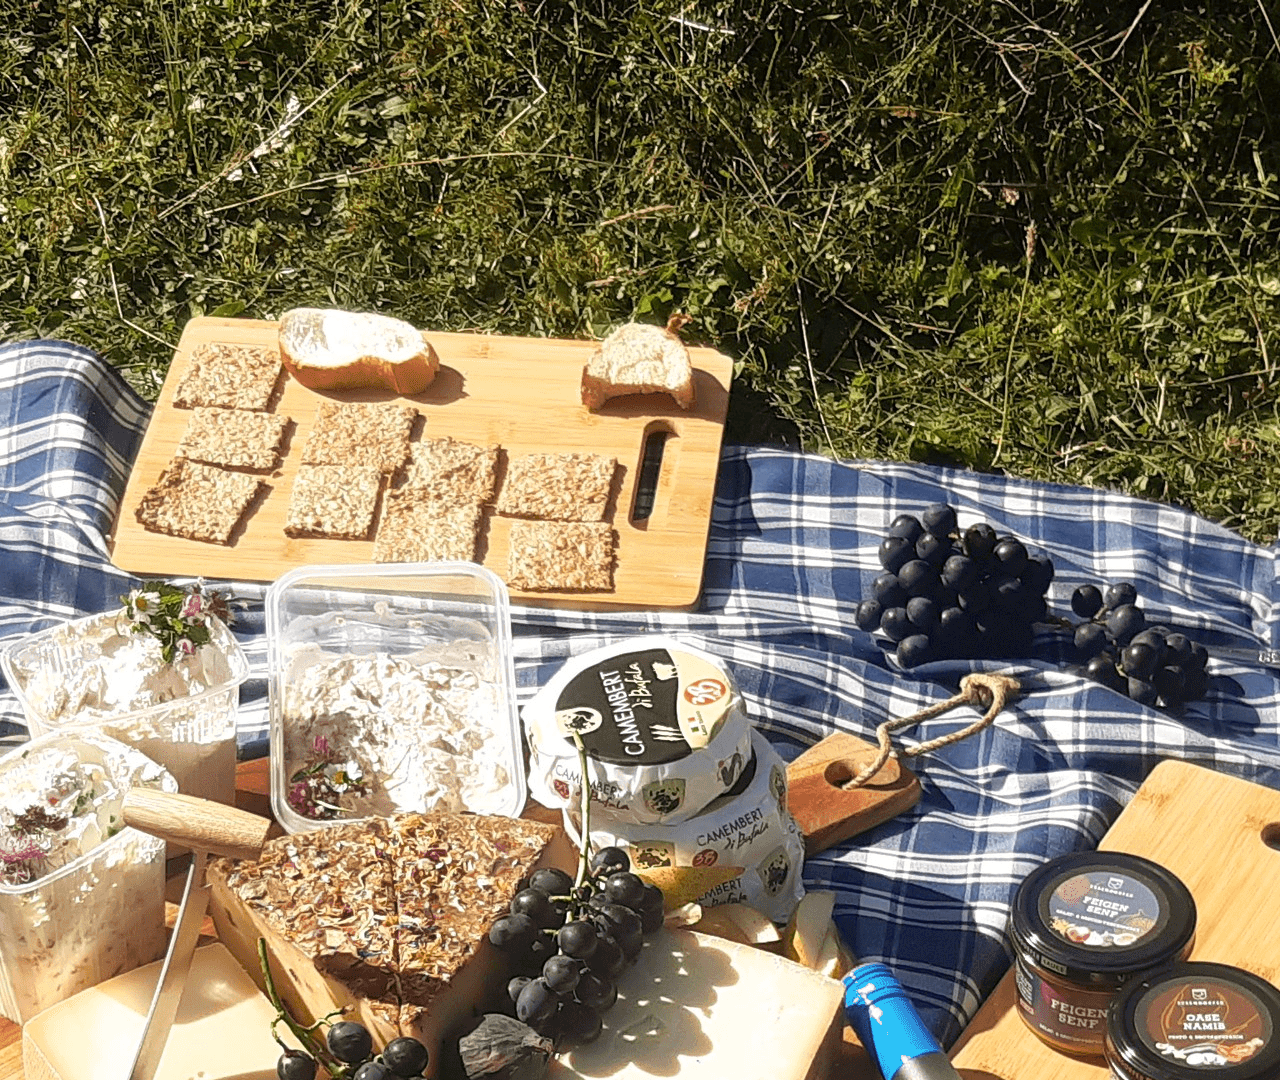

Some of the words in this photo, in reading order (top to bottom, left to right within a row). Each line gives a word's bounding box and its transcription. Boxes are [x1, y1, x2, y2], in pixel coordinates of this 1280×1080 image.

[623, 662, 653, 697] Bufala
[599, 669, 645, 756] CAMEMBERT
[696, 807, 764, 846] CAMEMBERT
[1083, 896, 1129, 912] FEIGEN
[1086, 905, 1119, 918] SENF
[1051, 998, 1109, 1018] FEIGEN
[1058, 1013, 1099, 1029] SENF
[1186, 1013, 1220, 1022] OASE
[1183, 1022, 1226, 1030] NAMIB
